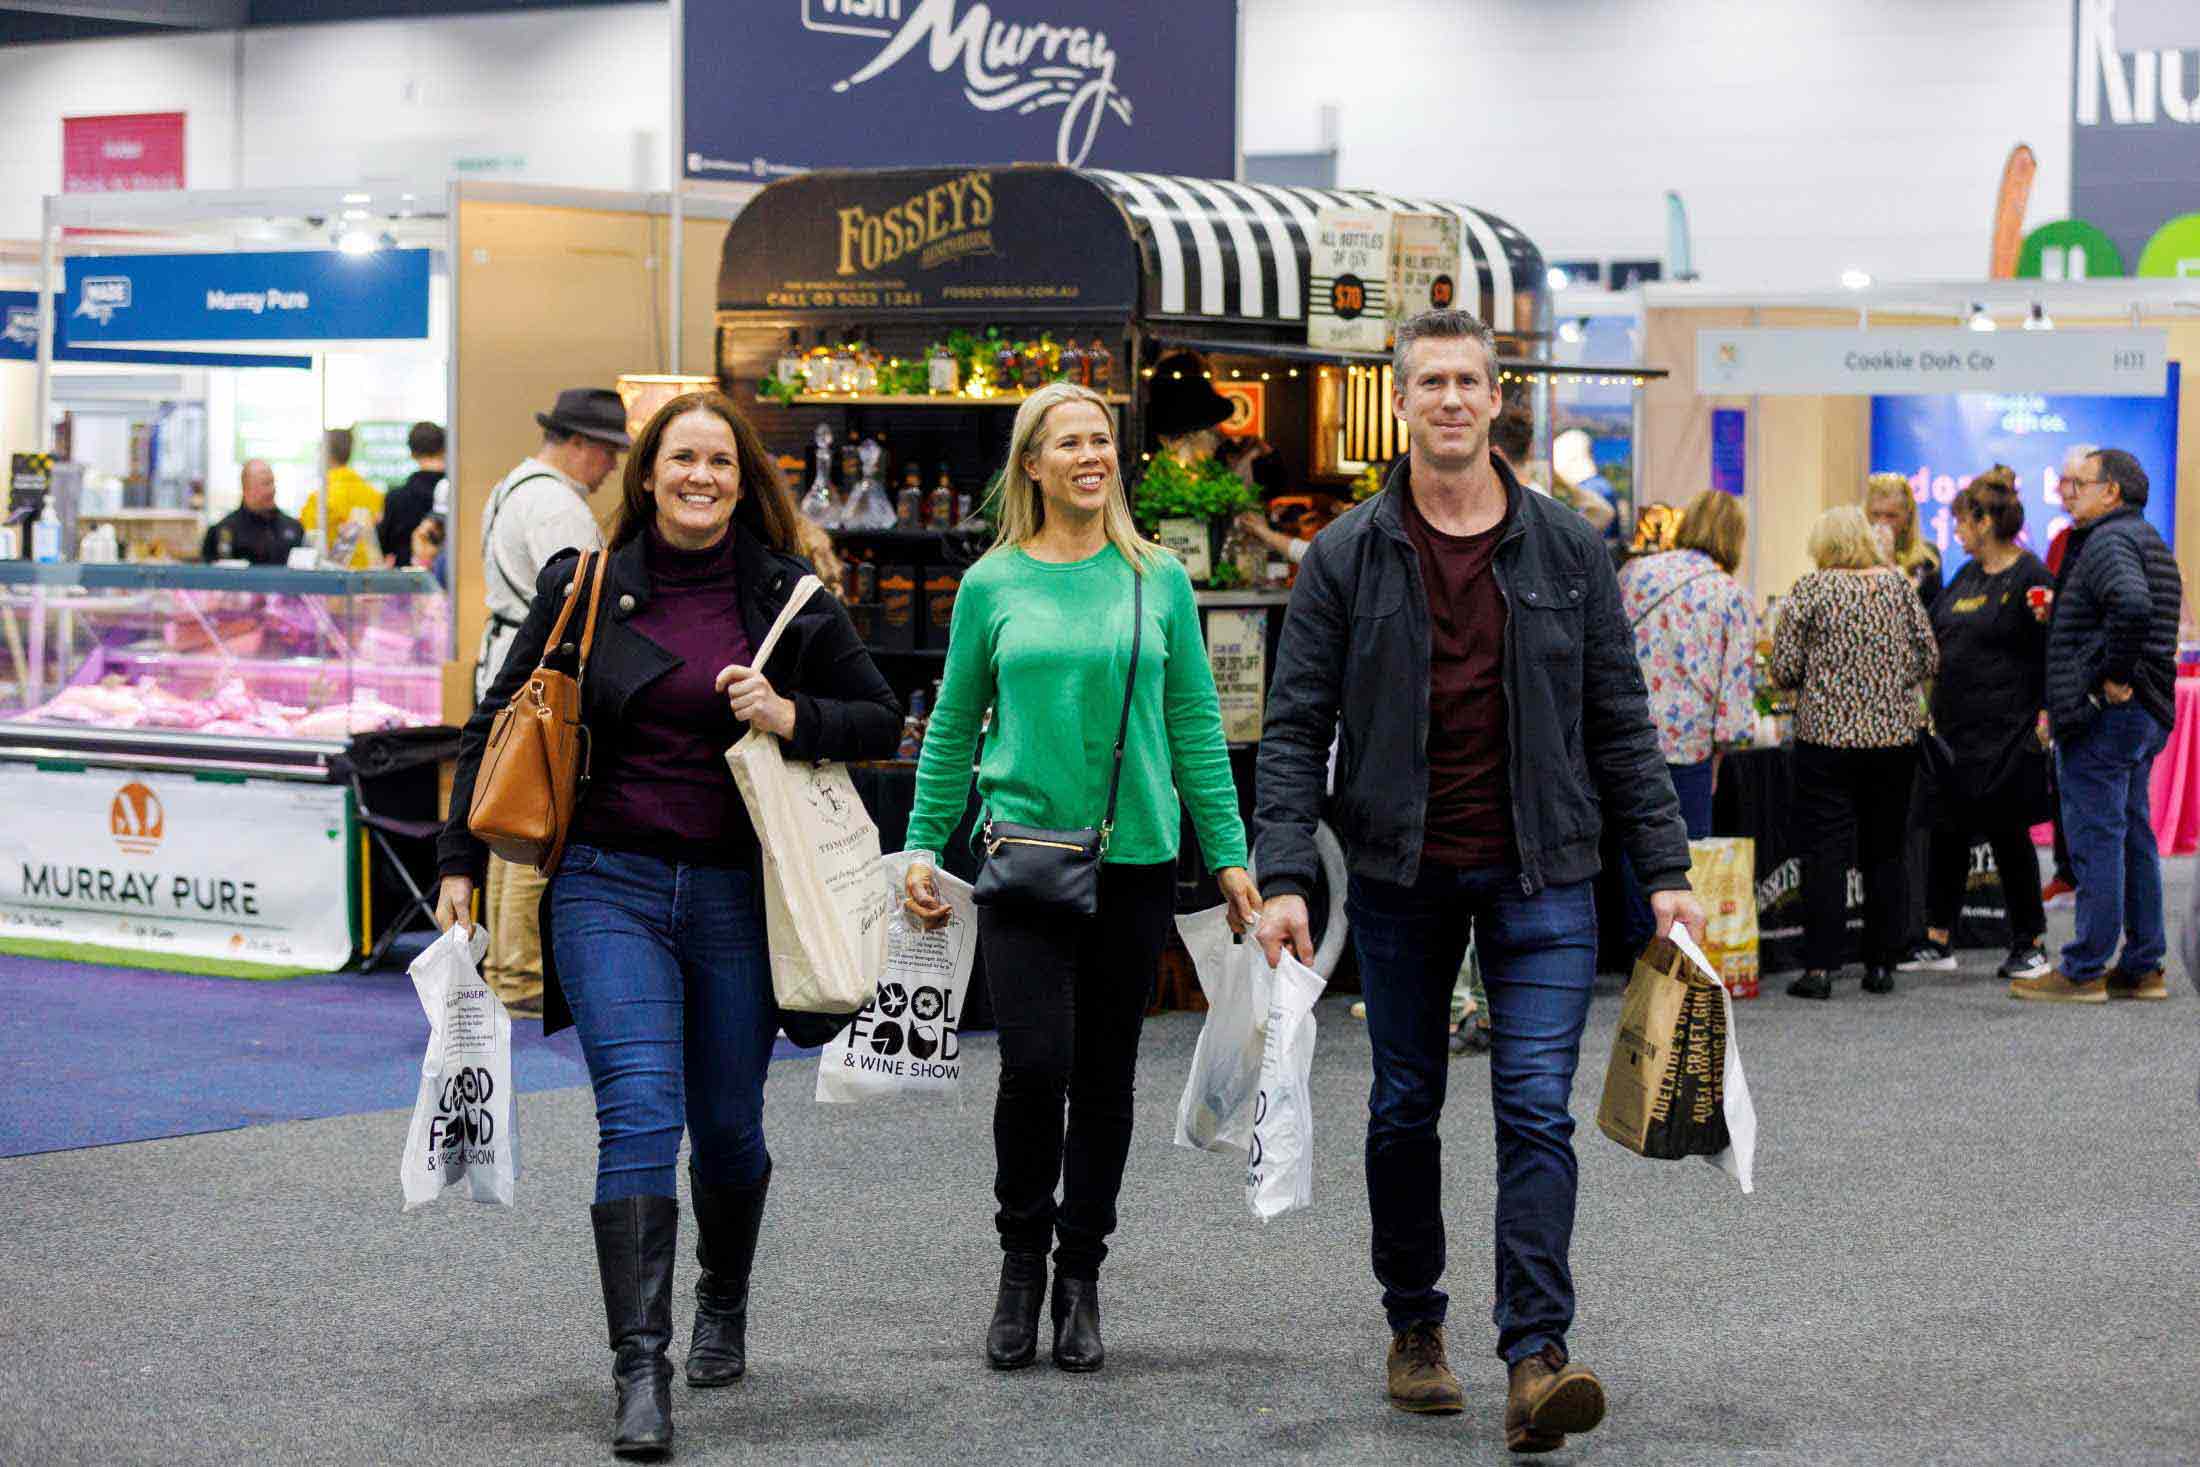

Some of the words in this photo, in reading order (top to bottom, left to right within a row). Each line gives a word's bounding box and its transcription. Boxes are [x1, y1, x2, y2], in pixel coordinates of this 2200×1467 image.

[832, 0, 1118, 168] Murray
[837, 172, 993, 276] FOSSEY'S
[1845, 351, 1912, 370] Cookie
[1919, 352, 1961, 370] Doh
[1967, 352, 1995, 371] Co
[22, 863, 160, 906] MURRAY
[171, 876, 259, 915] PURE
[1691, 990, 1712, 1019] GIN
[847, 1015, 960, 1061] FOOD
[1686, 1023, 1708, 1075] CRAFT
[860, 1055, 905, 1076] WINE
[909, 1062, 961, 1080] SHOW
